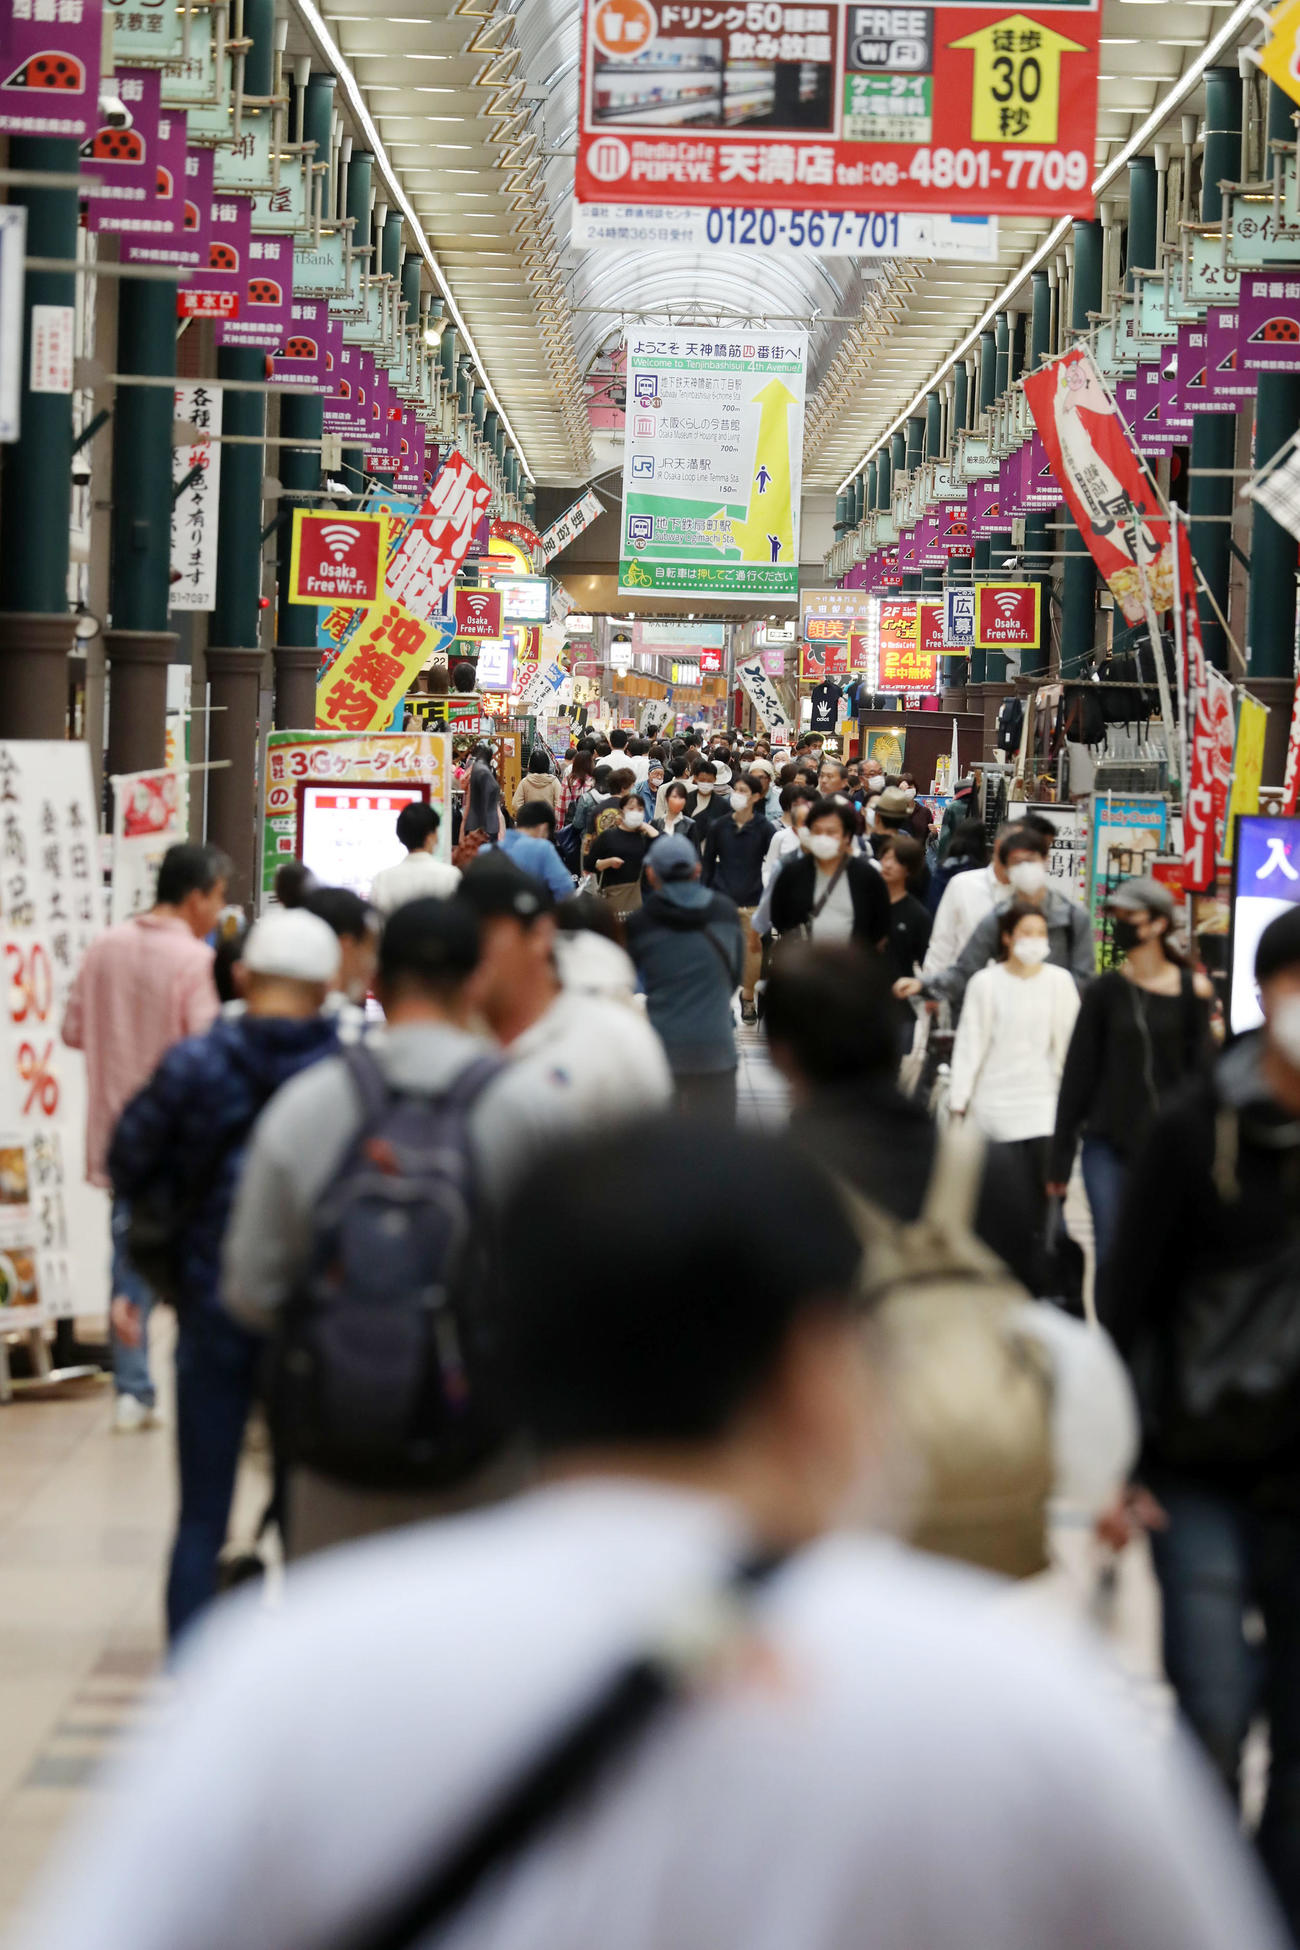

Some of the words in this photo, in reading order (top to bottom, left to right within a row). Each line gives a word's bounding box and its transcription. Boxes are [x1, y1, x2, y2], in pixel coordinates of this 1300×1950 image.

[855, 9, 927, 37] FREE
[992, 29, 1042, 53] 徒歩
[851, 75, 927, 96] ケータイ
[991, 56, 1041, 103] 30
[998, 107, 1031, 137] 秒
[718, 144, 835, 185] 天満店
[249, 242, 281, 260] 番街
[291, 305, 317, 320] 番街
[633, 341, 680, 356] ようこそ
[633, 357, 672, 368] Welcome
[674, 359, 684, 368] to
[747, 361, 765, 373] 4th
[722, 404, 741, 412] 700m
[659, 416, 741, 431] 大阪くらしの今昔館
[720, 444, 739, 452] 700m
[634, 461, 652, 472] JR
[657, 458, 711, 471] JR天満駅
[655, 531, 684, 543] Subway
[685, 532, 721, 544] Ogimachi
[319, 562, 357, 579] Osaka
[655, 566, 793, 582] 自転車は押してご通行ください
[307, 576, 335, 593] Free
[337, 579, 367, 596] Wi-Fi
[882, 606, 901, 617] 2F
[467, 615, 488, 625] Osaka
[994, 618, 1021, 628] Osaka
[460, 625, 476, 633] Free
[476, 626, 494, 634] Wi-Fi
[808, 619, 857, 639] 顔美
[986, 628, 1006, 639] Free
[1007, 629, 1028, 639] Wi-Fi
[884, 652, 932, 667] 24H
[315, 604, 427, 731] 沖縄物
[884, 667, 932, 680] 年中無休
[450, 718, 479, 734] SALE
[270, 788, 289, 806] の
